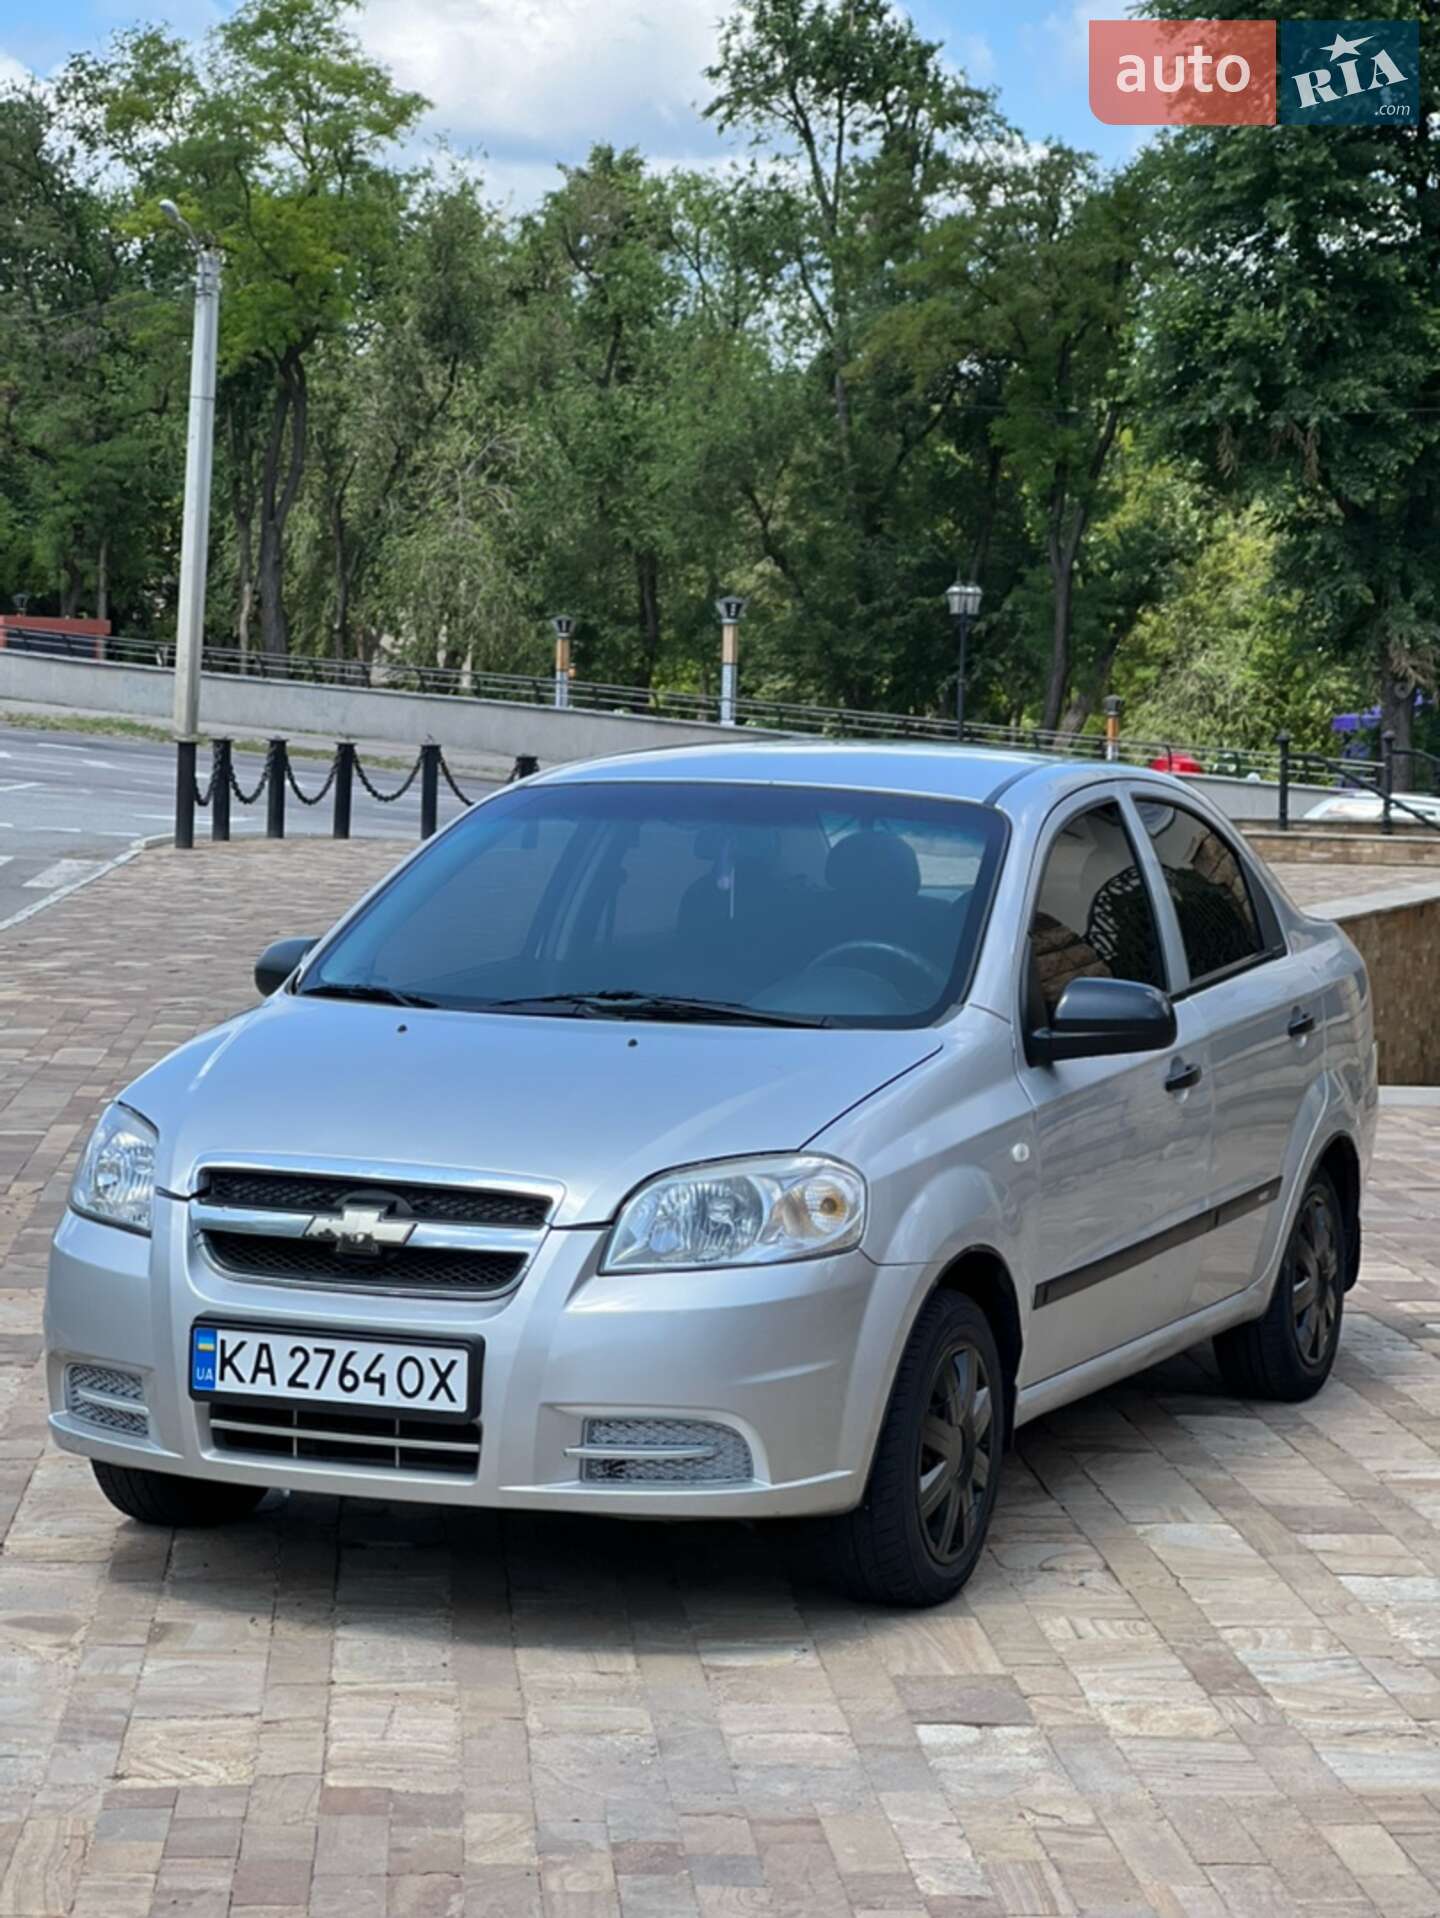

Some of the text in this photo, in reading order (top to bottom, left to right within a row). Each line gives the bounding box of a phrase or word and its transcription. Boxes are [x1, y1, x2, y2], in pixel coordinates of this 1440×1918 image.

[196, 1367, 214, 1381] UA
[218, 1338, 458, 1403] KA 2764 OX
